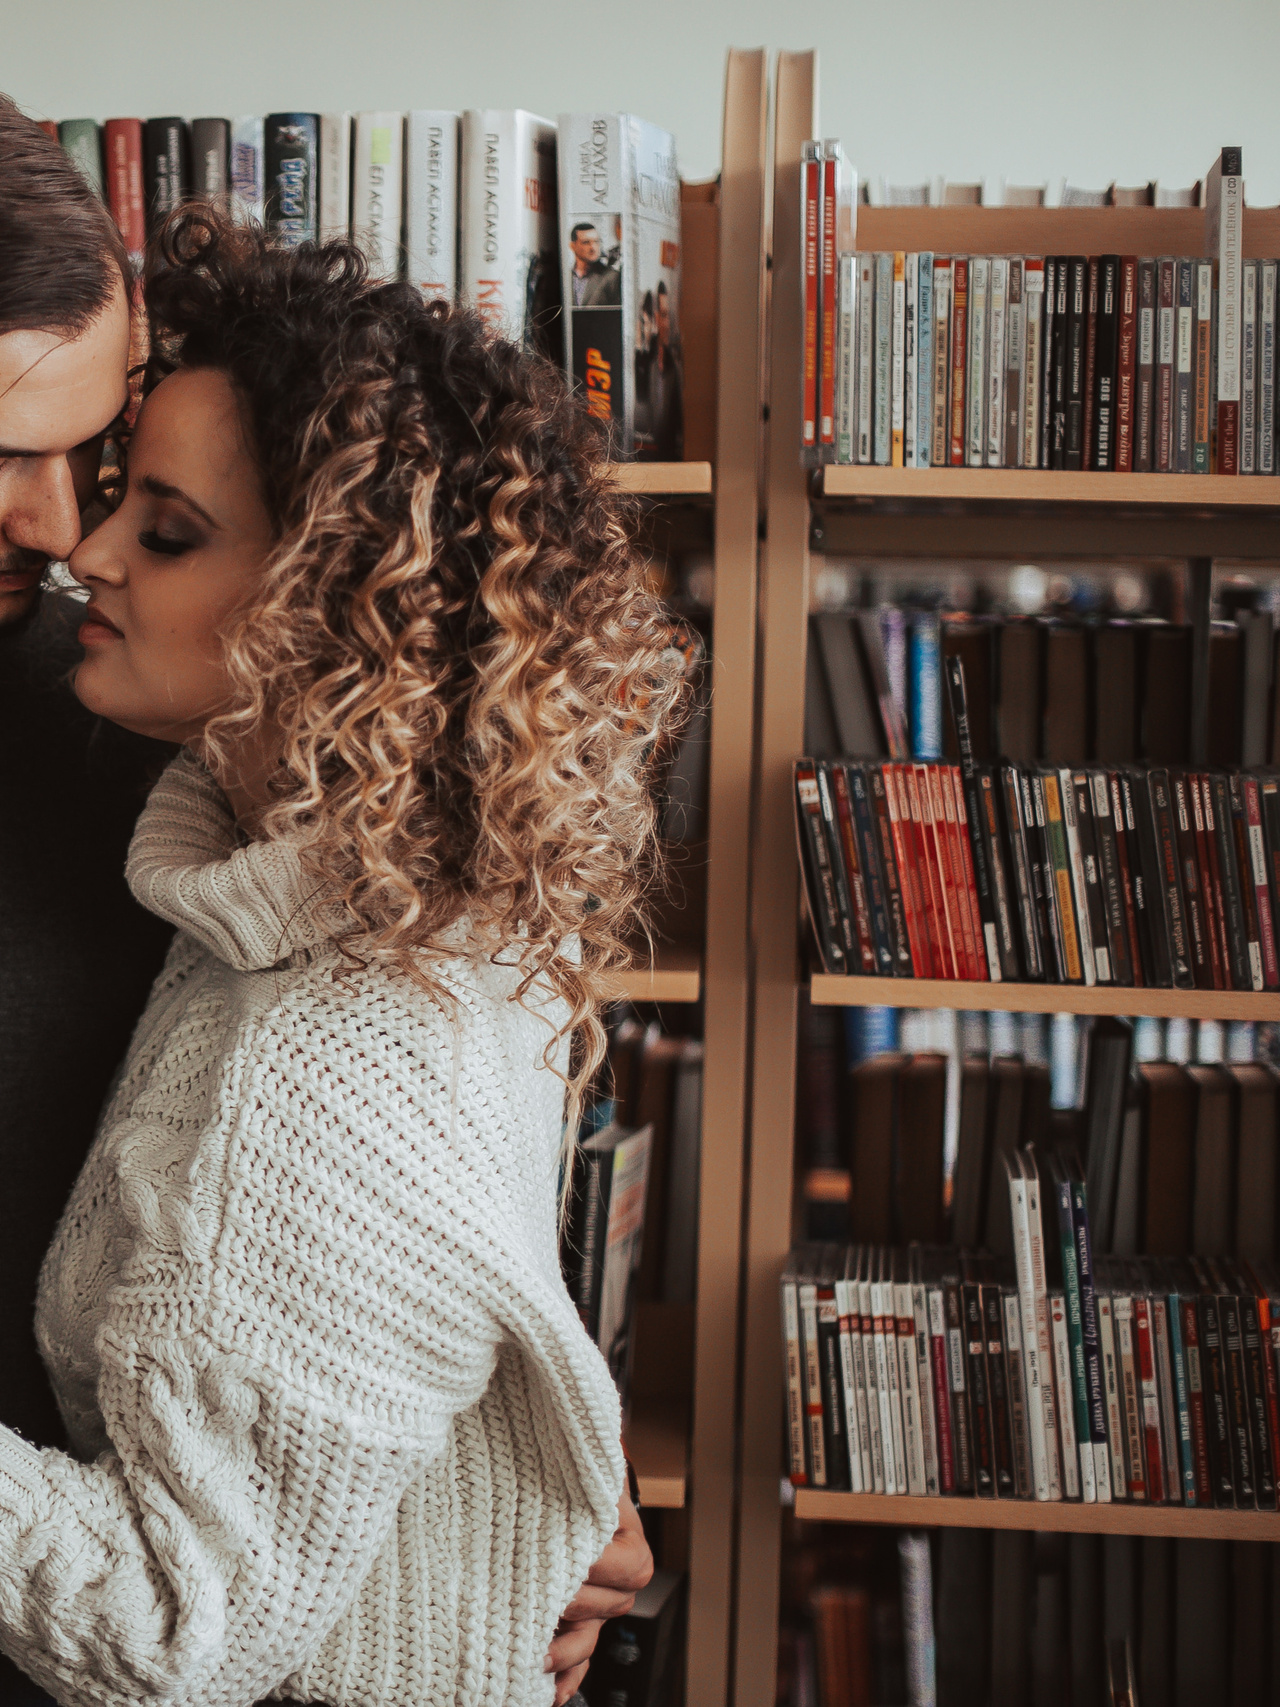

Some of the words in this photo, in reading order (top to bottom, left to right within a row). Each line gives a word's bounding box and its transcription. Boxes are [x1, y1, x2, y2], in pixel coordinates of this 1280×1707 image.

[427, 126, 442, 179] ПАВЕЛ
[483, 133, 500, 185] ПАВЕЛ
[591, 118, 608, 206] АСТАХОВ
[1228, 154, 1238, 172] Mp3
[1228, 178, 1237, 188] CD
[427, 183, 443, 256] АСТАХОВ
[483, 190, 500, 263] АСТАХОВ
[1226, 202, 1236, 248] ТЕЛЁНОК
[1182, 268, 1190, 296] АРДИС
[1224, 250, 1236, 298] ЗОЛОТОЙ
[1225, 304, 1234, 350] СТУЛЬЕВ
[1225, 351, 1234, 360] 12
[1264, 356, 1272, 379] ПЕТРОВ
[586, 347, 611, 420] МЭР
[1100, 378, 1110, 402] ЗОВ
[1223, 405, 1234, 421] best
[1245, 390, 1253, 428] ЗОЛОТОЙ
[1264, 384, 1272, 432] ДВЕНАДЦАТЬ
[1098, 408, 1110, 466] ПРИПЯТИ
[1224, 424, 1233, 435] the
[1224, 438, 1234, 470] АРДИС
[1264, 434, 1272, 468] СТУЛЬЕВ
[1088, 1353, 1100, 1399] РУБИНА
[1092, 1401, 1104, 1433] ДИНА
[1254, 1397, 1264, 1419] ДЕТИ
[1216, 1412, 1225, 1440] АРБАТА
[1237, 1427, 1246, 1446] ДЕТИ
[1257, 1420, 1267, 1451] АРБАТА
[1239, 1447, 1249, 1477] АРБАТА
